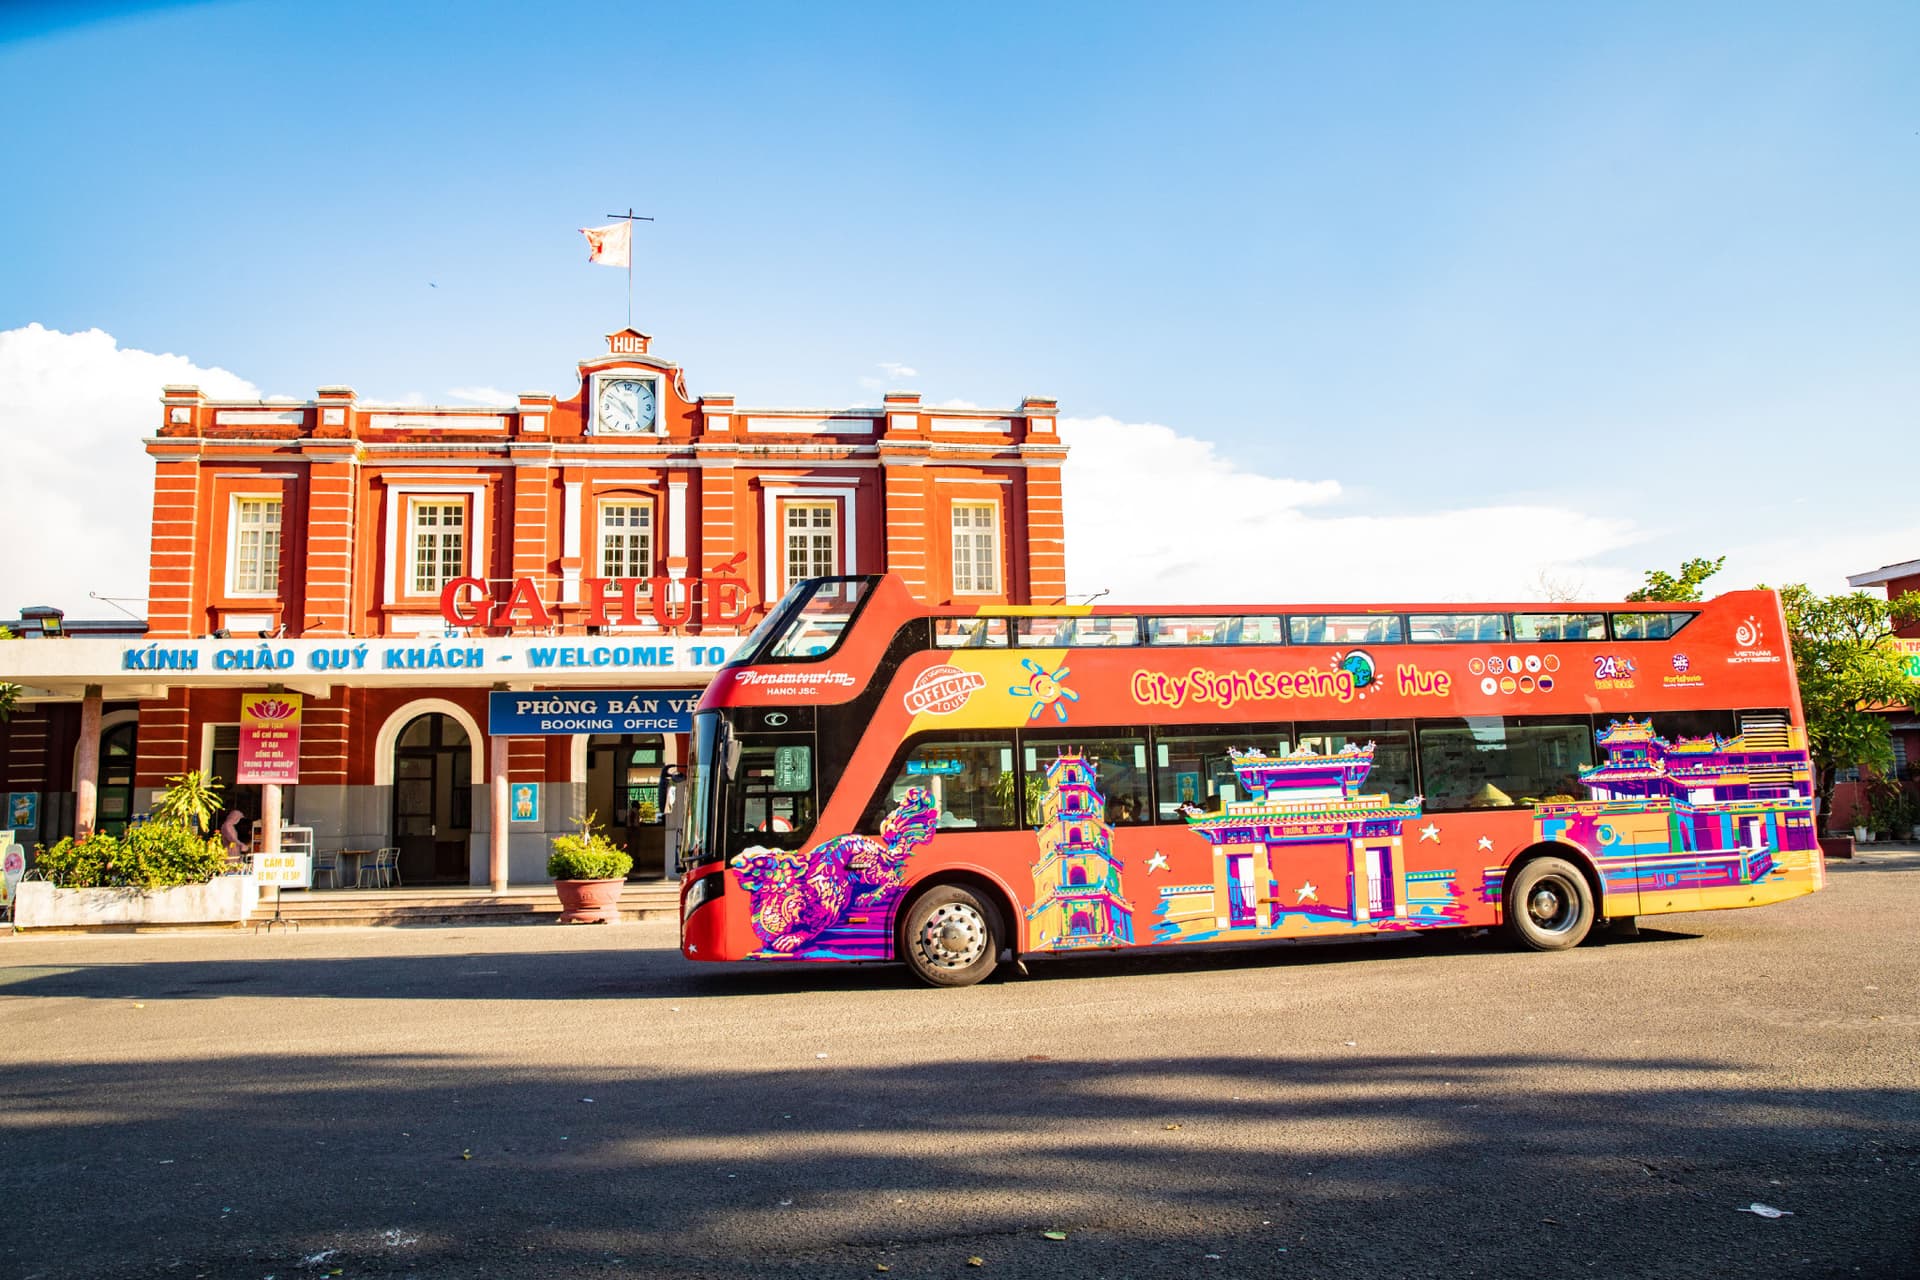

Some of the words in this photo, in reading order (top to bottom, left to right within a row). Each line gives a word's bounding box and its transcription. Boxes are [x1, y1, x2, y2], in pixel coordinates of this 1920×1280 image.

[614, 337, 644, 353] HUE
[646, 404, 652, 412] 3
[439, 576, 551, 627] GA
[584, 552, 754, 627] HUẾ
[125, 643, 199, 670] KÍNH
[215, 643, 295, 670] CHÀO
[311, 643, 369, 671] QUÝ
[384, 643, 484, 669] KHÁCH
[529, 647, 675, 667] WELCOME
[691, 646, 725, 665] TO
[735, 670, 856, 686] Vietnamtourism
[1397, 663, 1451, 697] Hue
[767, 687, 796, 695] HANOI
[913, 675, 978, 708] OFFICIAL
[516, 696, 598, 715] PHÒNG
[607, 696, 660, 714] BÁN
[936, 694, 967, 711] TOUR
[541, 719, 613, 730] BOOKING
[623, 718, 679, 729] OFFICE
